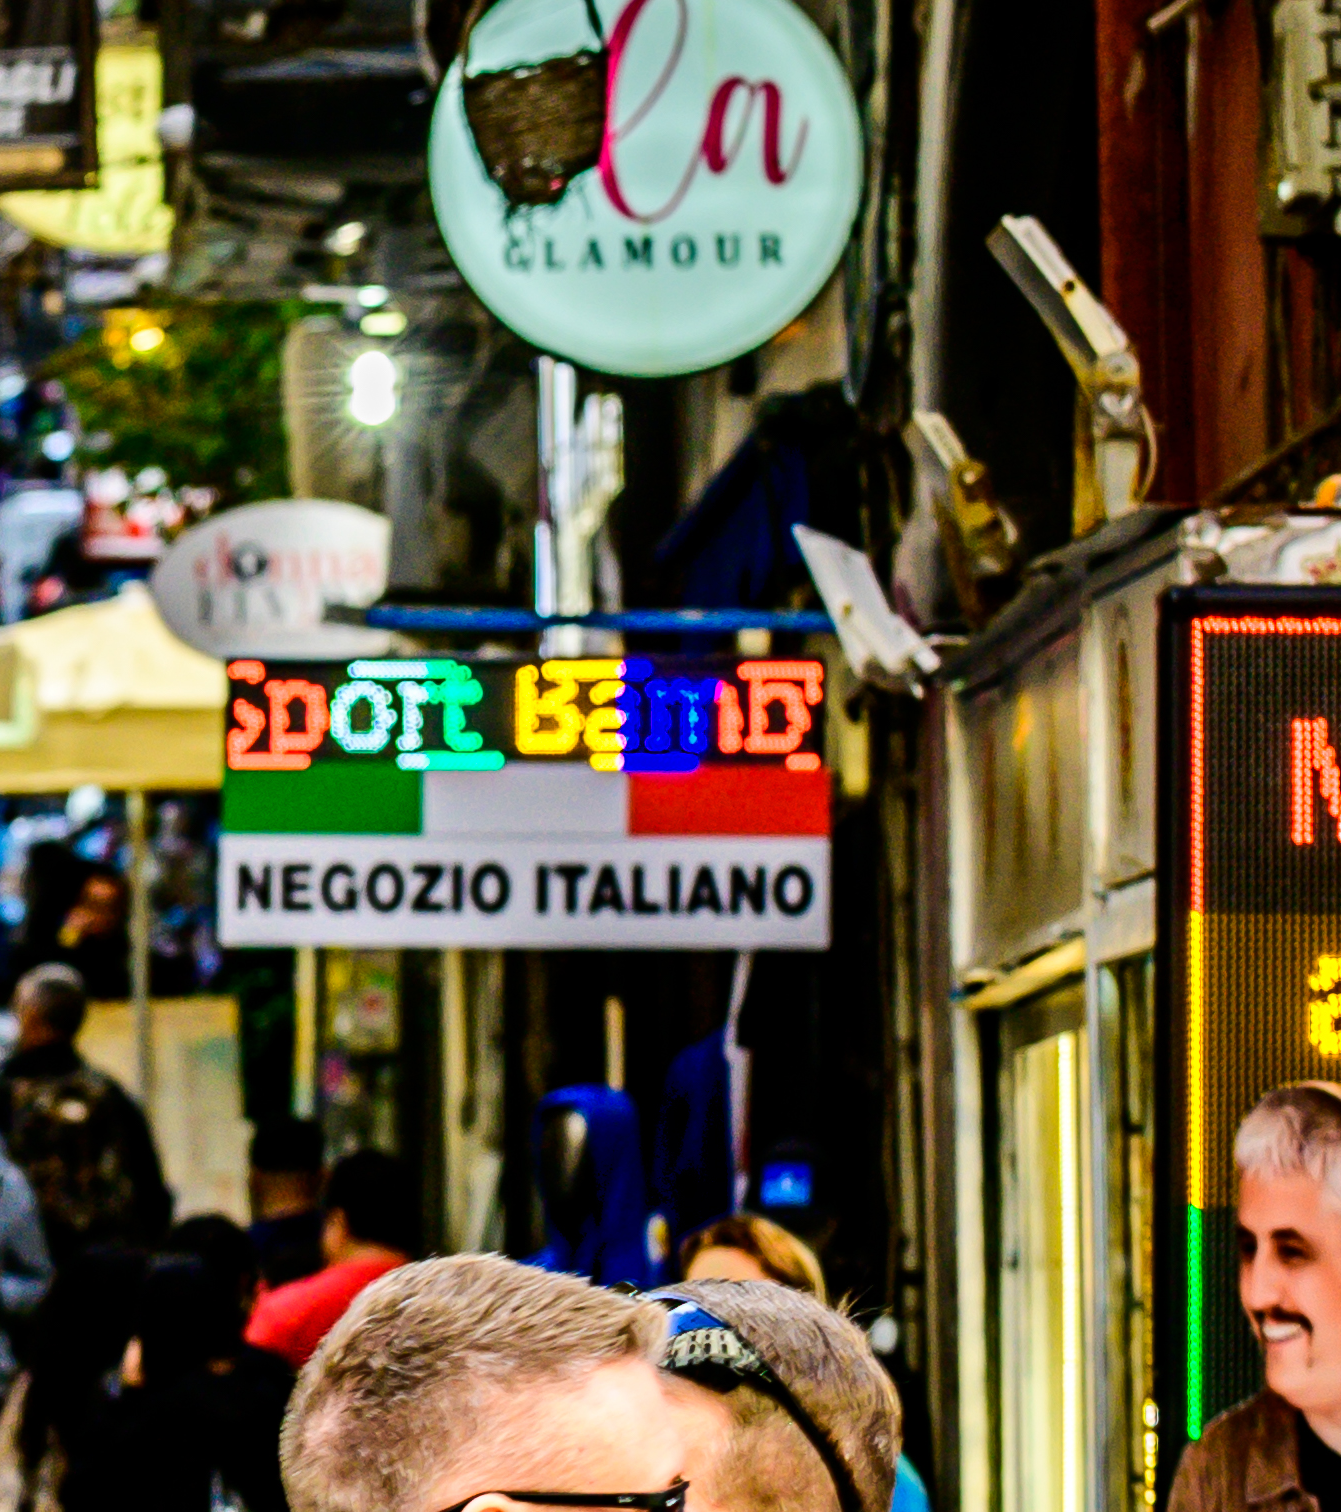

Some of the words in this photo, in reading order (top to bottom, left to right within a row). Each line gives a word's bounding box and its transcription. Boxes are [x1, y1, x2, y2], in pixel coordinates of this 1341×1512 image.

[504, 233, 784, 273] GLAMOUR
[237, 861, 511, 916] NEGOZIO
[537, 861, 814, 916] ITALIANO
